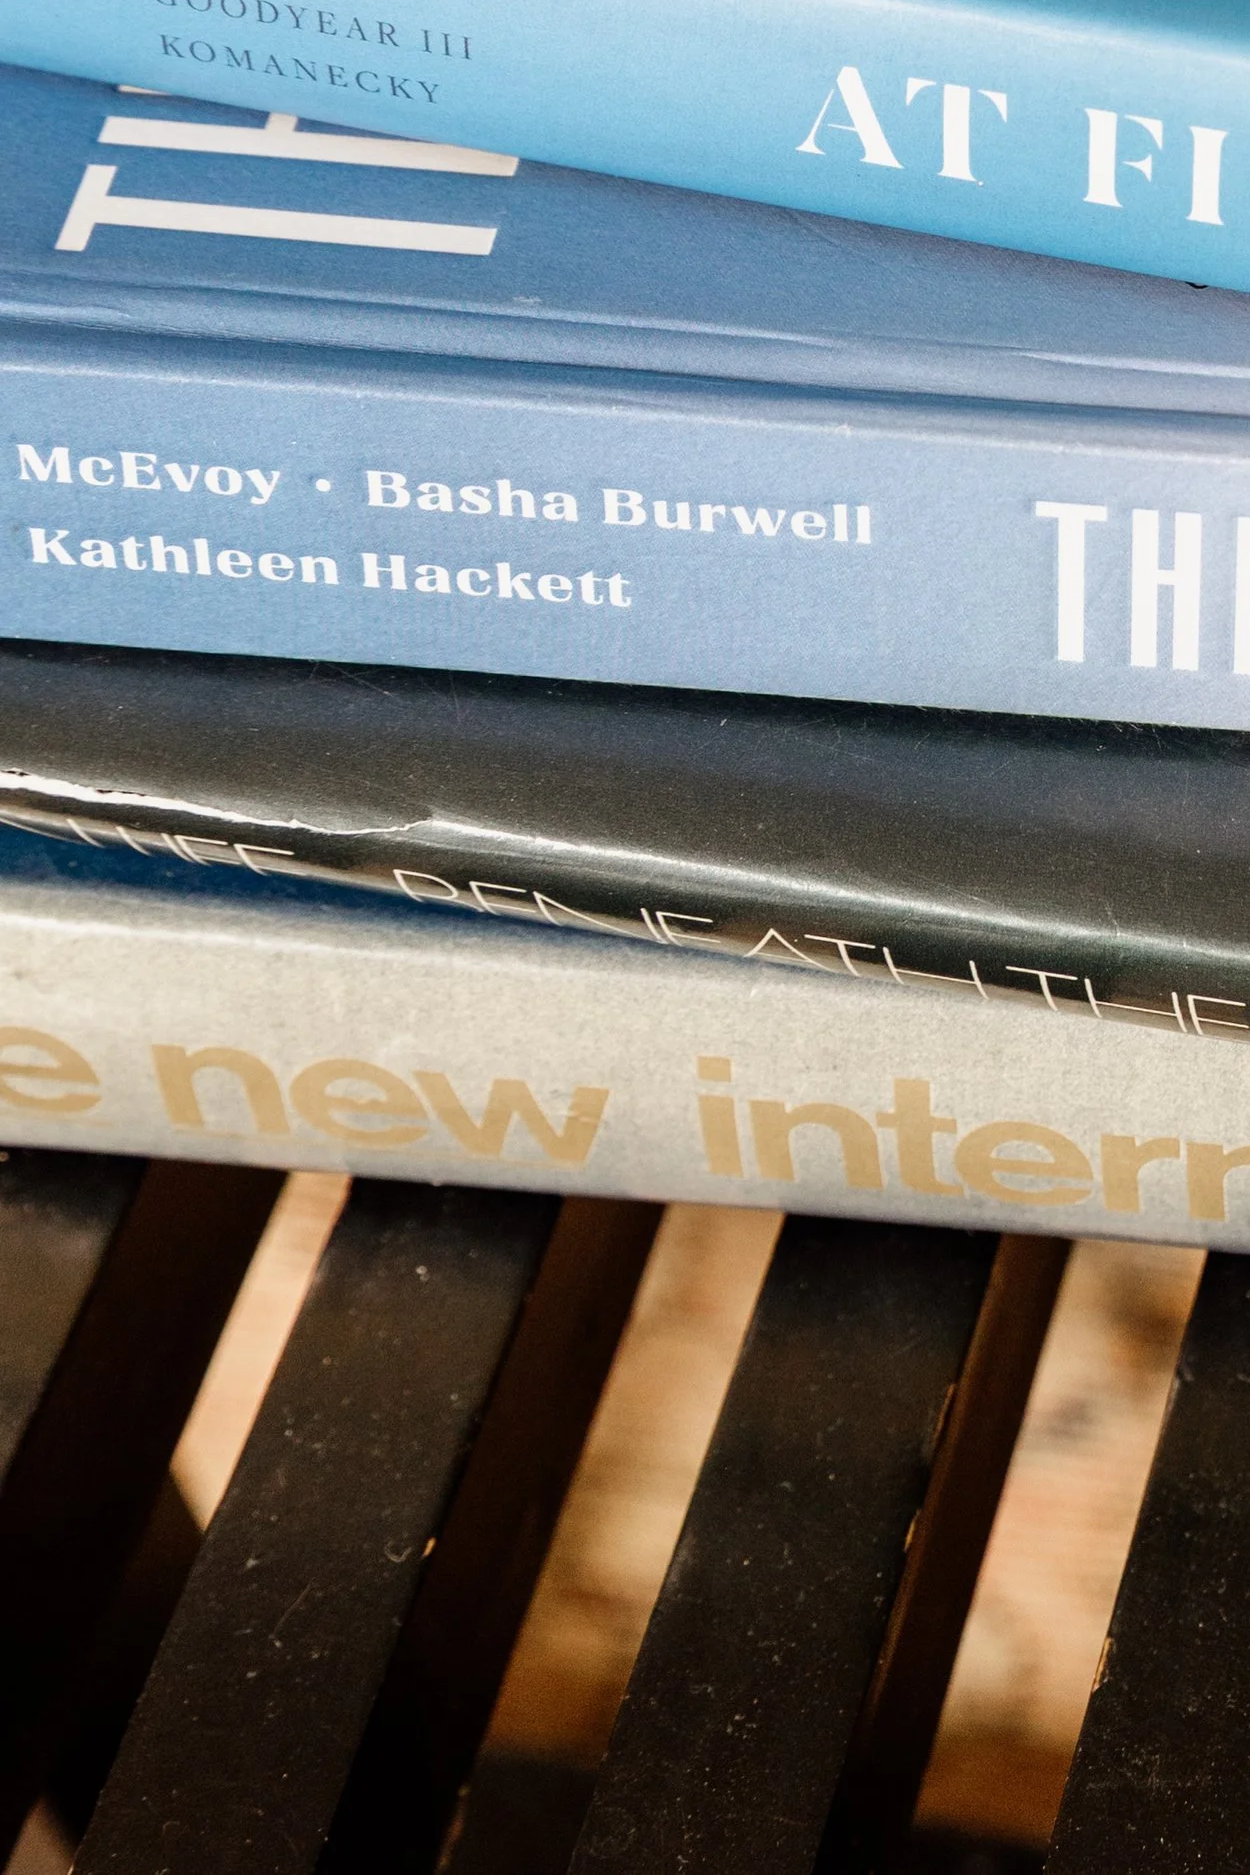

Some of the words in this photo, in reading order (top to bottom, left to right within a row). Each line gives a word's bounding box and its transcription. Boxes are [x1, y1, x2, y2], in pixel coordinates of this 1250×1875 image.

[160, 33, 442, 105] KOMANECKY
[421, 28, 474, 60] III
[795, 65, 1008, 187] AT
[17, 443, 281, 505] McEvoy
[366, 470, 579, 522] Basha
[602, 487, 873, 545] Burwell
[29, 527, 338, 585] Kathleen
[361, 552, 632, 608] Hackett
[151, 1042, 610, 1166] new
